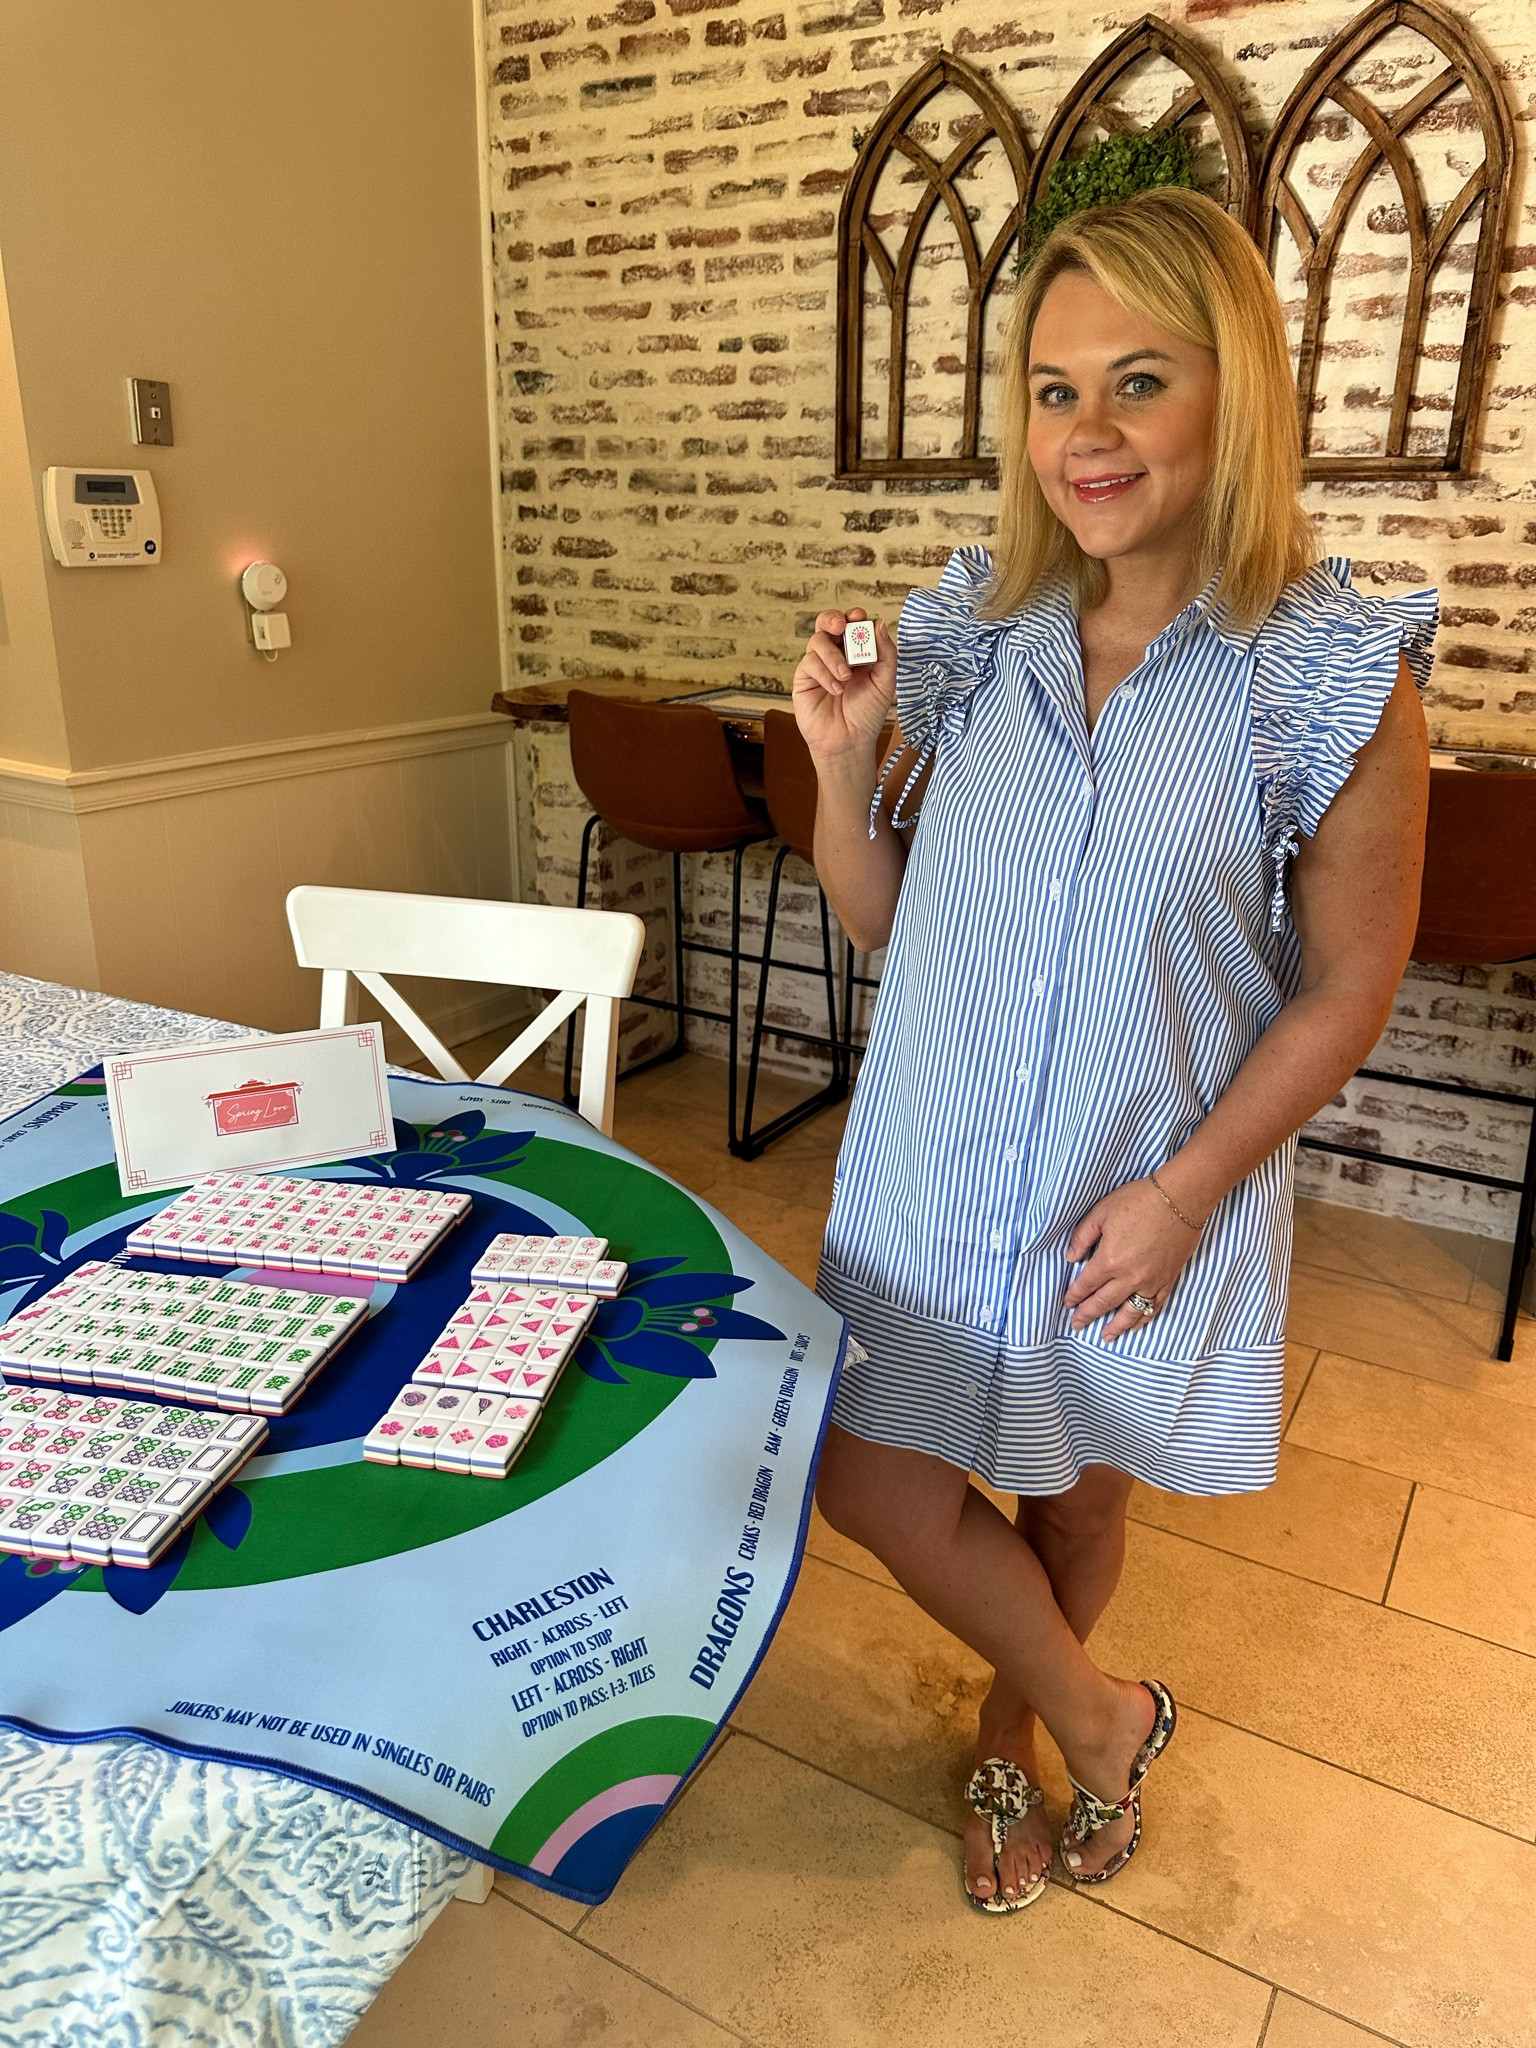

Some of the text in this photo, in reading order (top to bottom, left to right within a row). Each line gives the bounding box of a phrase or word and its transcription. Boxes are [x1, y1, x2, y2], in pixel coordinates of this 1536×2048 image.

[23, 1101, 78, 1129] DRAGONS
[227, 1098, 289, 1124] Spring Love
[444, 1196, 462, 1206] 中
[426, 1214, 445, 1224] 中
[409, 1232, 429, 1242] 中
[389, 1251, 409, 1261] 中
[779, 1367, 799, 1400] DRAGON
[772, 1397, 792, 1428] GREEN
[764, 1432, 782, 1456] BAM
[752, 1464, 774, 1501] DRAGON
[748, 1499, 764, 1521] RED
[738, 1525, 761, 1561] CRAKS
[472, 1567, 615, 1642] CHARLESTON
[490, 1638, 533, 1668] RIGHT
[541, 1612, 593, 1646] ACROSS
[598, 1595, 629, 1619] LEFT
[689, 1566, 755, 1691] DRAGONS
[530, 1628, 613, 1676] OPTION TO STOP
[511, 1684, 543, 1712] LEFT
[553, 1657, 604, 1695] ACROSS
[610, 1636, 649, 1668] RIGHT
[522, 1707, 563, 1738] OPTION
[563, 1700, 578, 1718] TO
[579, 1687, 609, 1711] PASS:
[628, 1664, 656, 1688] TILES
[165, 1700, 496, 1808] JOKERS MAY NOT BE USED IN SINGLES OR PAIRS
